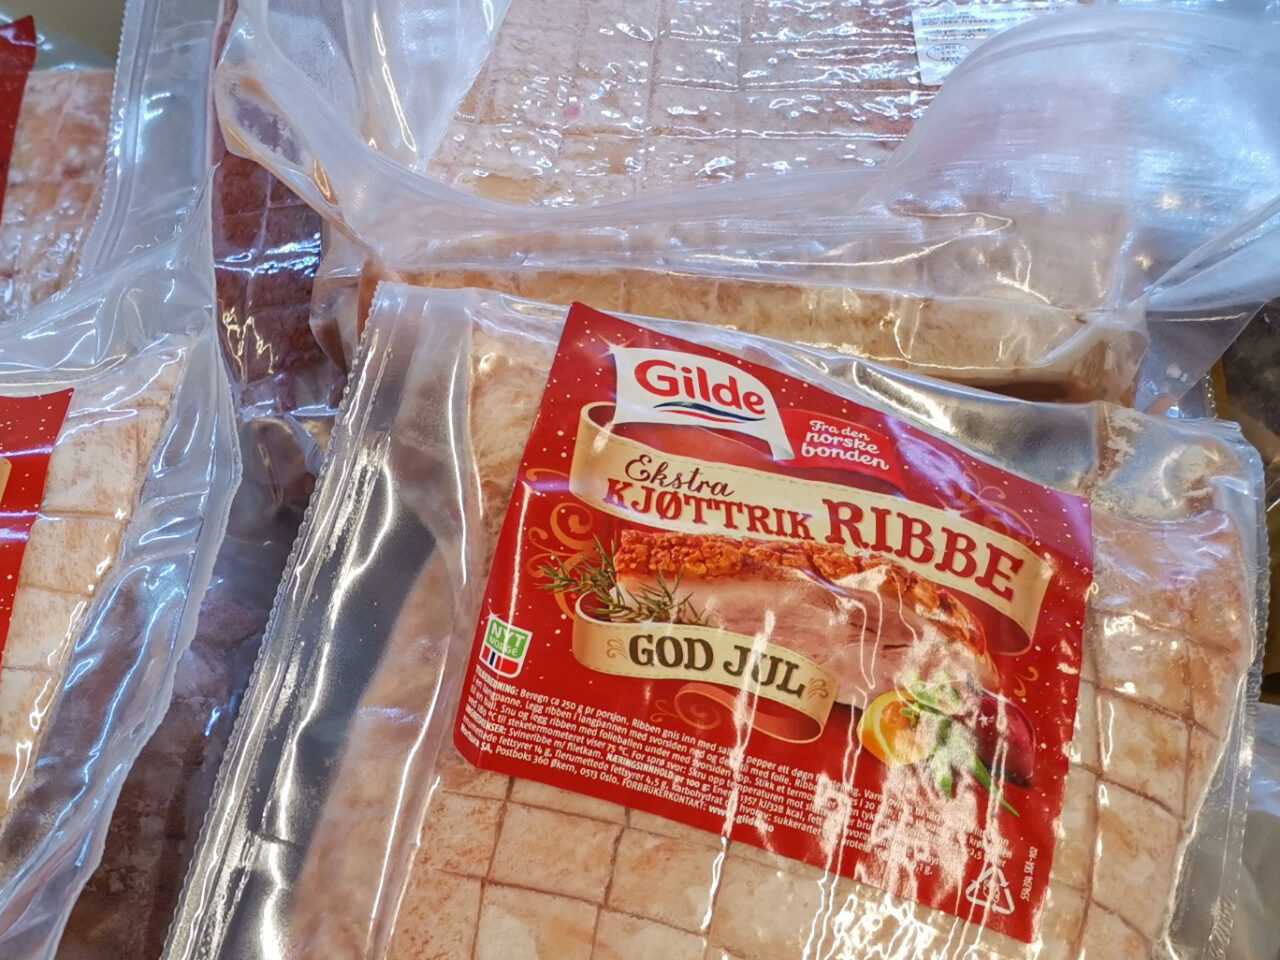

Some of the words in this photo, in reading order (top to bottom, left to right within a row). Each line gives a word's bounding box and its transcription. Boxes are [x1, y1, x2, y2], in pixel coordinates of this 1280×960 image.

[634, 359, 765, 415] Gilde
[805, 431, 880, 455] norske
[809, 420, 839, 434] Fra
[841, 426, 871, 441] den
[625, 454, 735, 497] Ekstra
[801, 443, 889, 470] bonden
[602, 478, 814, 541] KJØTTRIK
[822, 498, 1024, 603] RIBBE
[489, 637, 521, 657] NORGE
[491, 622, 528, 648] NYT
[629, 634, 714, 671] GOD
[723, 644, 807, 698] JUL
[500, 705, 516, 716] Snu
[518, 710, 528, 720] og
[531, 712, 548, 725] legg
[550, 716, 576, 731] ribben
[645, 745, 670, 758] under
[672, 753, 691, 764] med
[520, 689, 549, 703] Beregn
[551, 697, 560, 705] ca
[562, 699, 576, 709] 250
[578, 705, 583, 714] g
[585, 707, 595, 716] pr
[596, 708, 629, 725] porsjon.
[632, 718, 661, 734] Ribben
[662, 729, 680, 740] gnis
[682, 734, 696, 744] inn
[698, 738, 717, 750] med
[526, 700, 543, 714] Legg
[545, 704, 572, 720] ribben
[579, 714, 627, 735] langpannen
[507, 715, 584, 744] steketermometeret
[586, 737, 606, 748] viser
[632, 748, 645, 759] For
[646, 754, 665, 767] sprø
[666, 761, 686, 773] svor:
[689, 767, 706, 780] Skru
[708, 775, 725, 787] opp
[508, 727, 552, 745] Svineribbe
[567, 742, 603, 759] filetkam.
[606, 753, 674, 778] NÆRINGSINNHOLD
[495, 744, 532, 761] Postboks
[533, 753, 548, 765] 360
[550, 756, 578, 774] Økern,
[580, 768, 598, 779] 0513
[599, 770, 619, 785] Oslo.
[622, 779, 707, 811] FORBRUKERKONTAKT:
